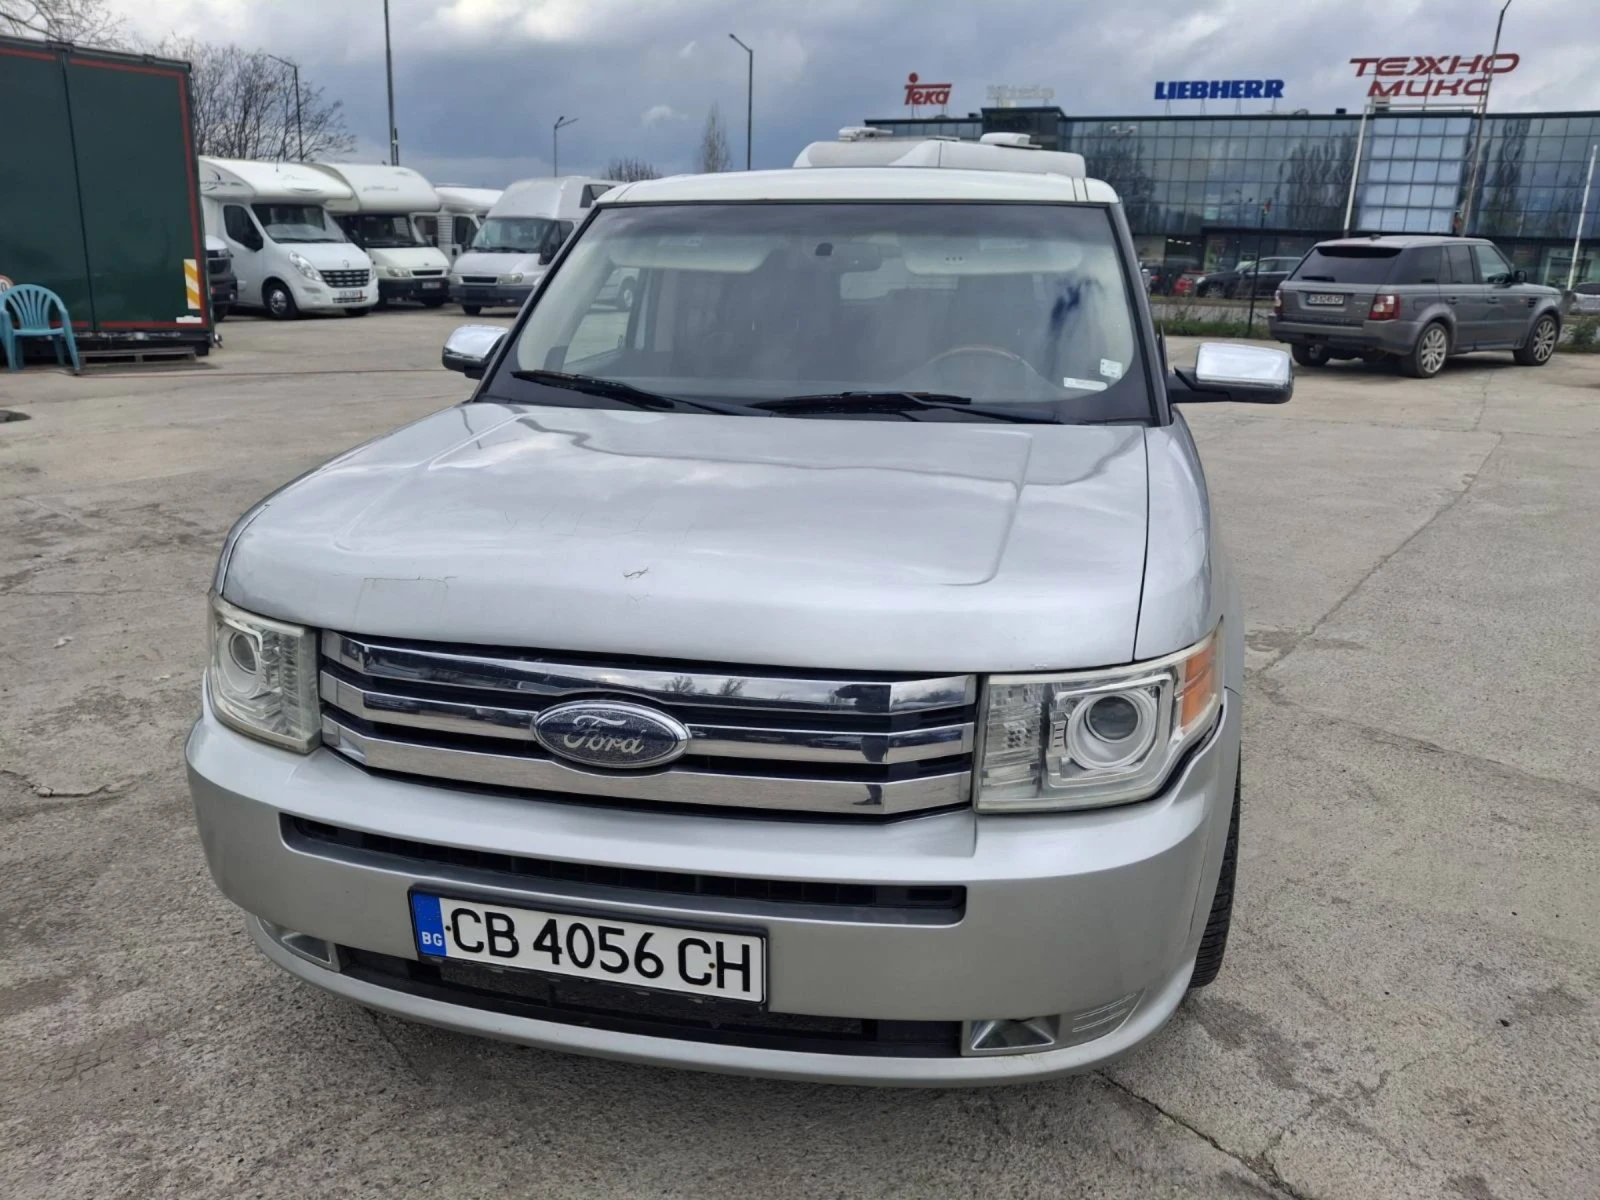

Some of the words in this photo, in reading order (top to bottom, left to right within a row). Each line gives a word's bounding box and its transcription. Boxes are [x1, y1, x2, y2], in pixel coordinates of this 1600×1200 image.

[1154, 79, 1284, 100] LIEBHERR
[563, 715, 647, 754] Ford
[421, 931, 443, 947] BG
[450, 907, 520, 959] CB
[532, 918, 664, 979] 4056
[677, 937, 751, 993] CH
